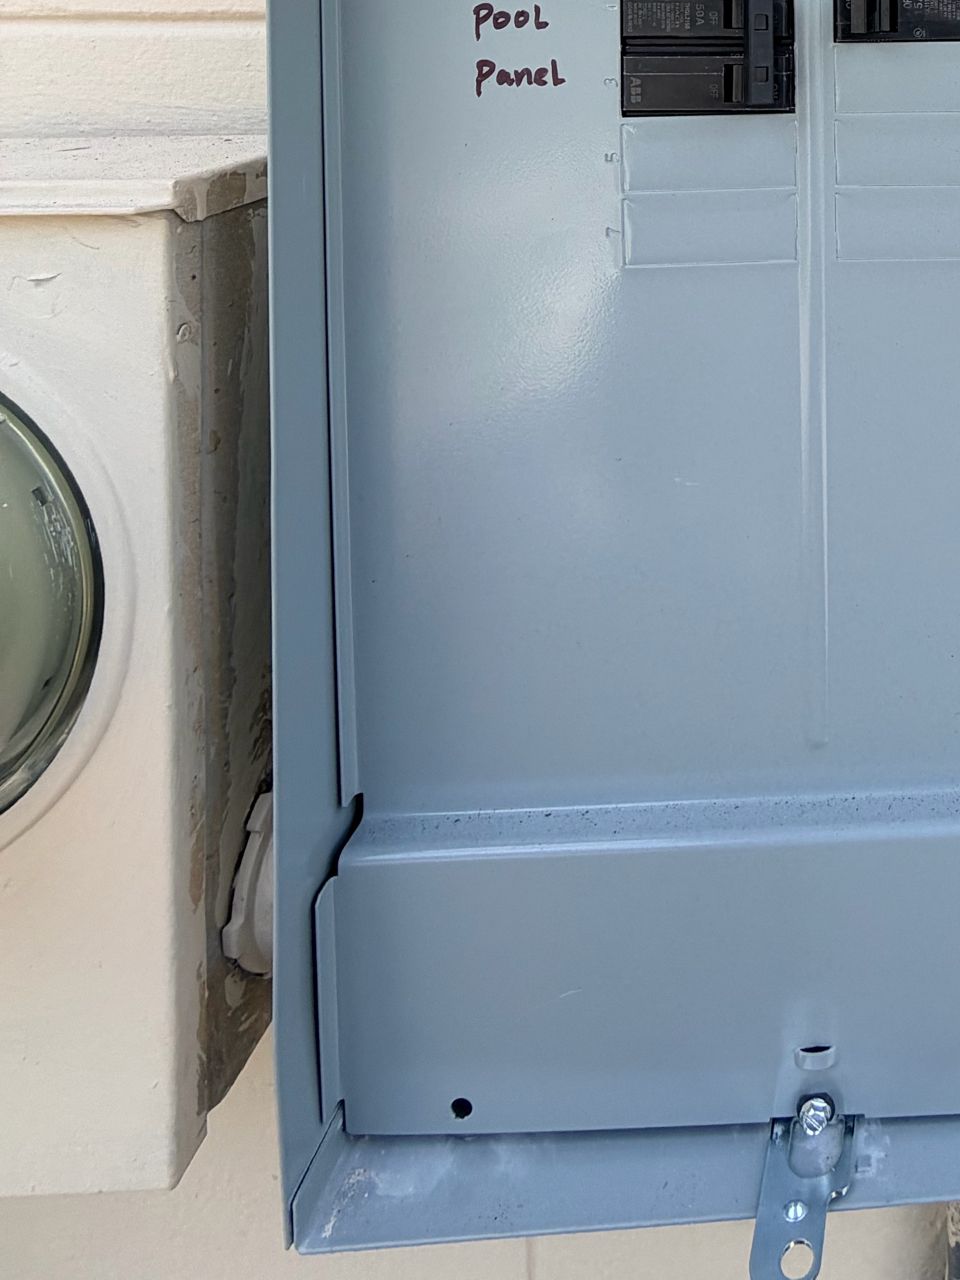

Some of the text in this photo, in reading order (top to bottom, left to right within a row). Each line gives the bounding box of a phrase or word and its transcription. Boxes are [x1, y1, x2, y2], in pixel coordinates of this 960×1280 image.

[696, 3, 705, 25] 50A
[709, 11, 718, 25] OFF
[604, 78, 619, 88] 3
[630, 77, 642, 103] ABB
[605, 152, 619, 162] 5
